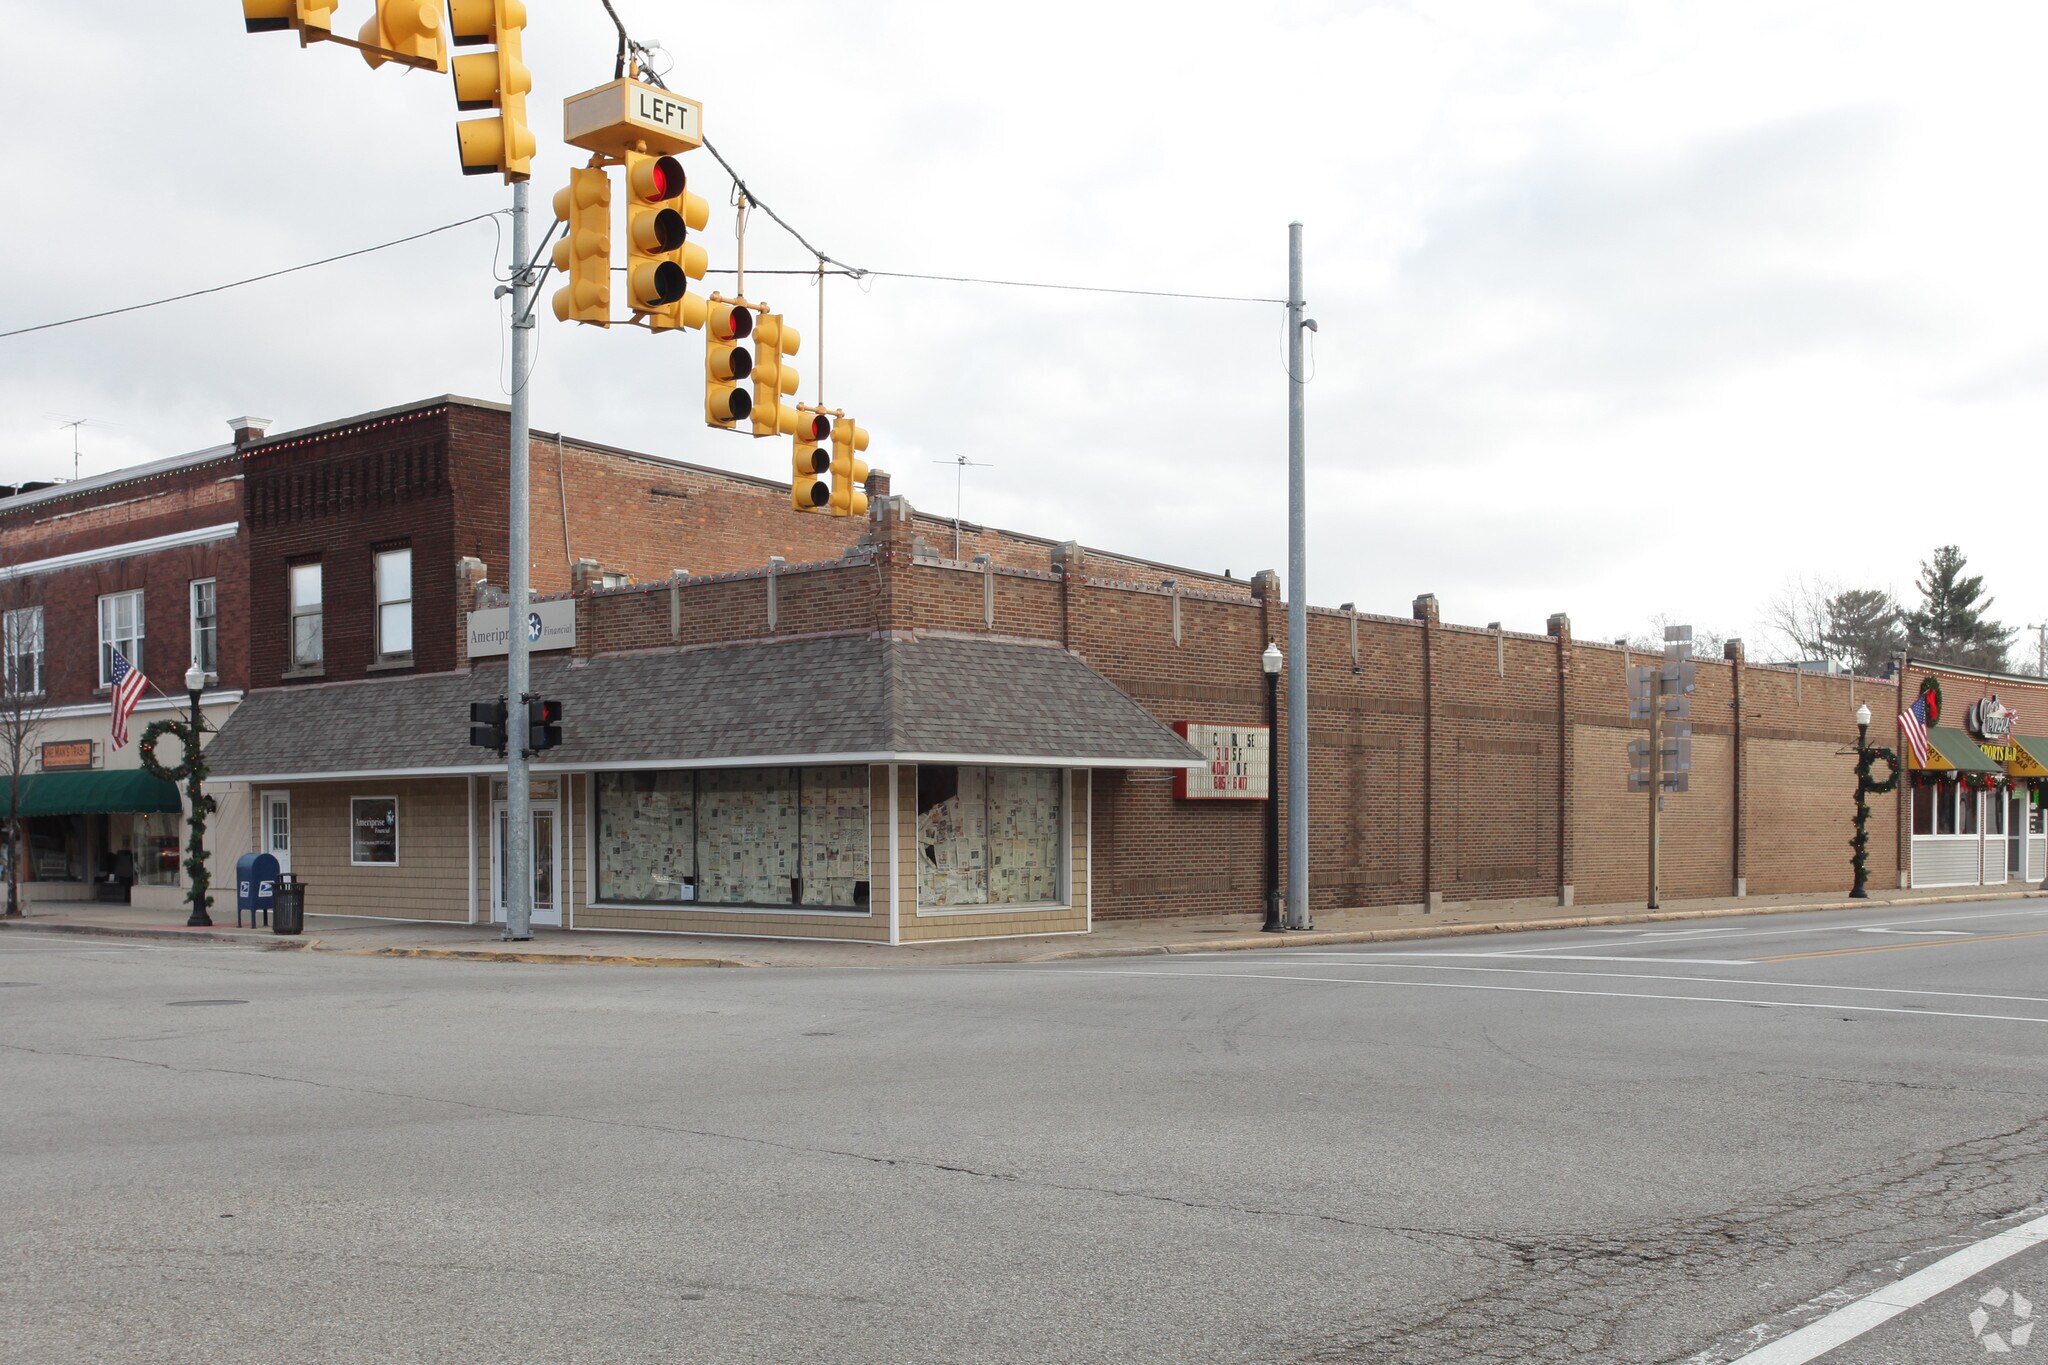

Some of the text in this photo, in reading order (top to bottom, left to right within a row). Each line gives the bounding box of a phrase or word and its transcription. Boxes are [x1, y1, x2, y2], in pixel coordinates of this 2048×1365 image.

[640, 93, 688, 130] LEFT
[470, 623, 572, 645] Ameripr Financial
[1988, 716, 2011, 733] PIZZA
[2016, 744, 2039, 769] SPORTS
[2016, 755, 2029, 771] BAR
[355, 817, 385, 829] Ameriprise
